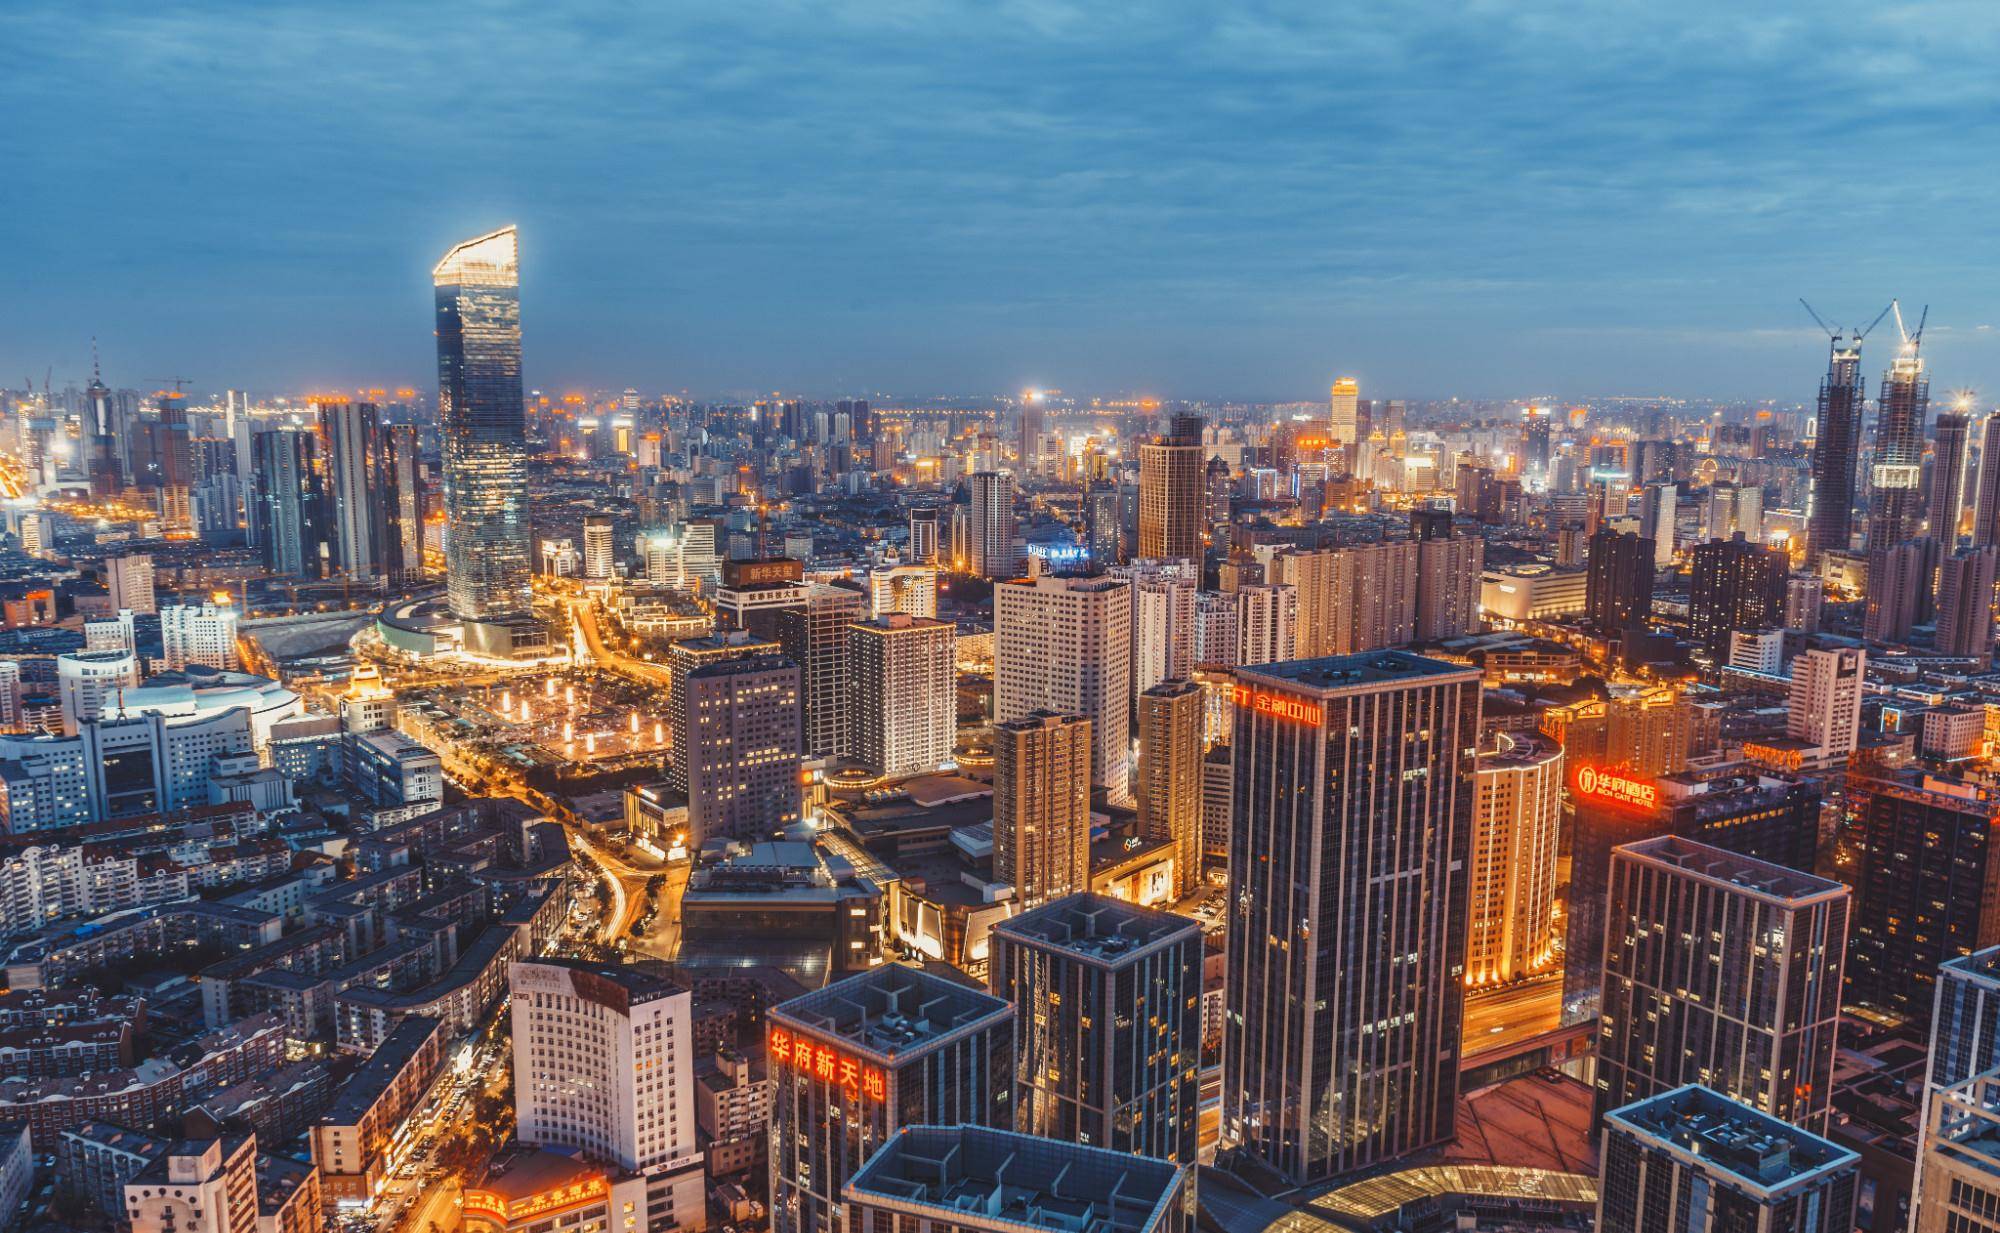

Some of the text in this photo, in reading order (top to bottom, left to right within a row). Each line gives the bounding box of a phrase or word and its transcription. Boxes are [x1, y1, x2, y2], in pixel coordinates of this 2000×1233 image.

[1256, 694, 1321, 726] 金融中心
[1615, 792, 1631, 803] GATE
[1633, 798, 1655, 809] HOTEL
[771, 1031, 884, 1101] 华府新天地
